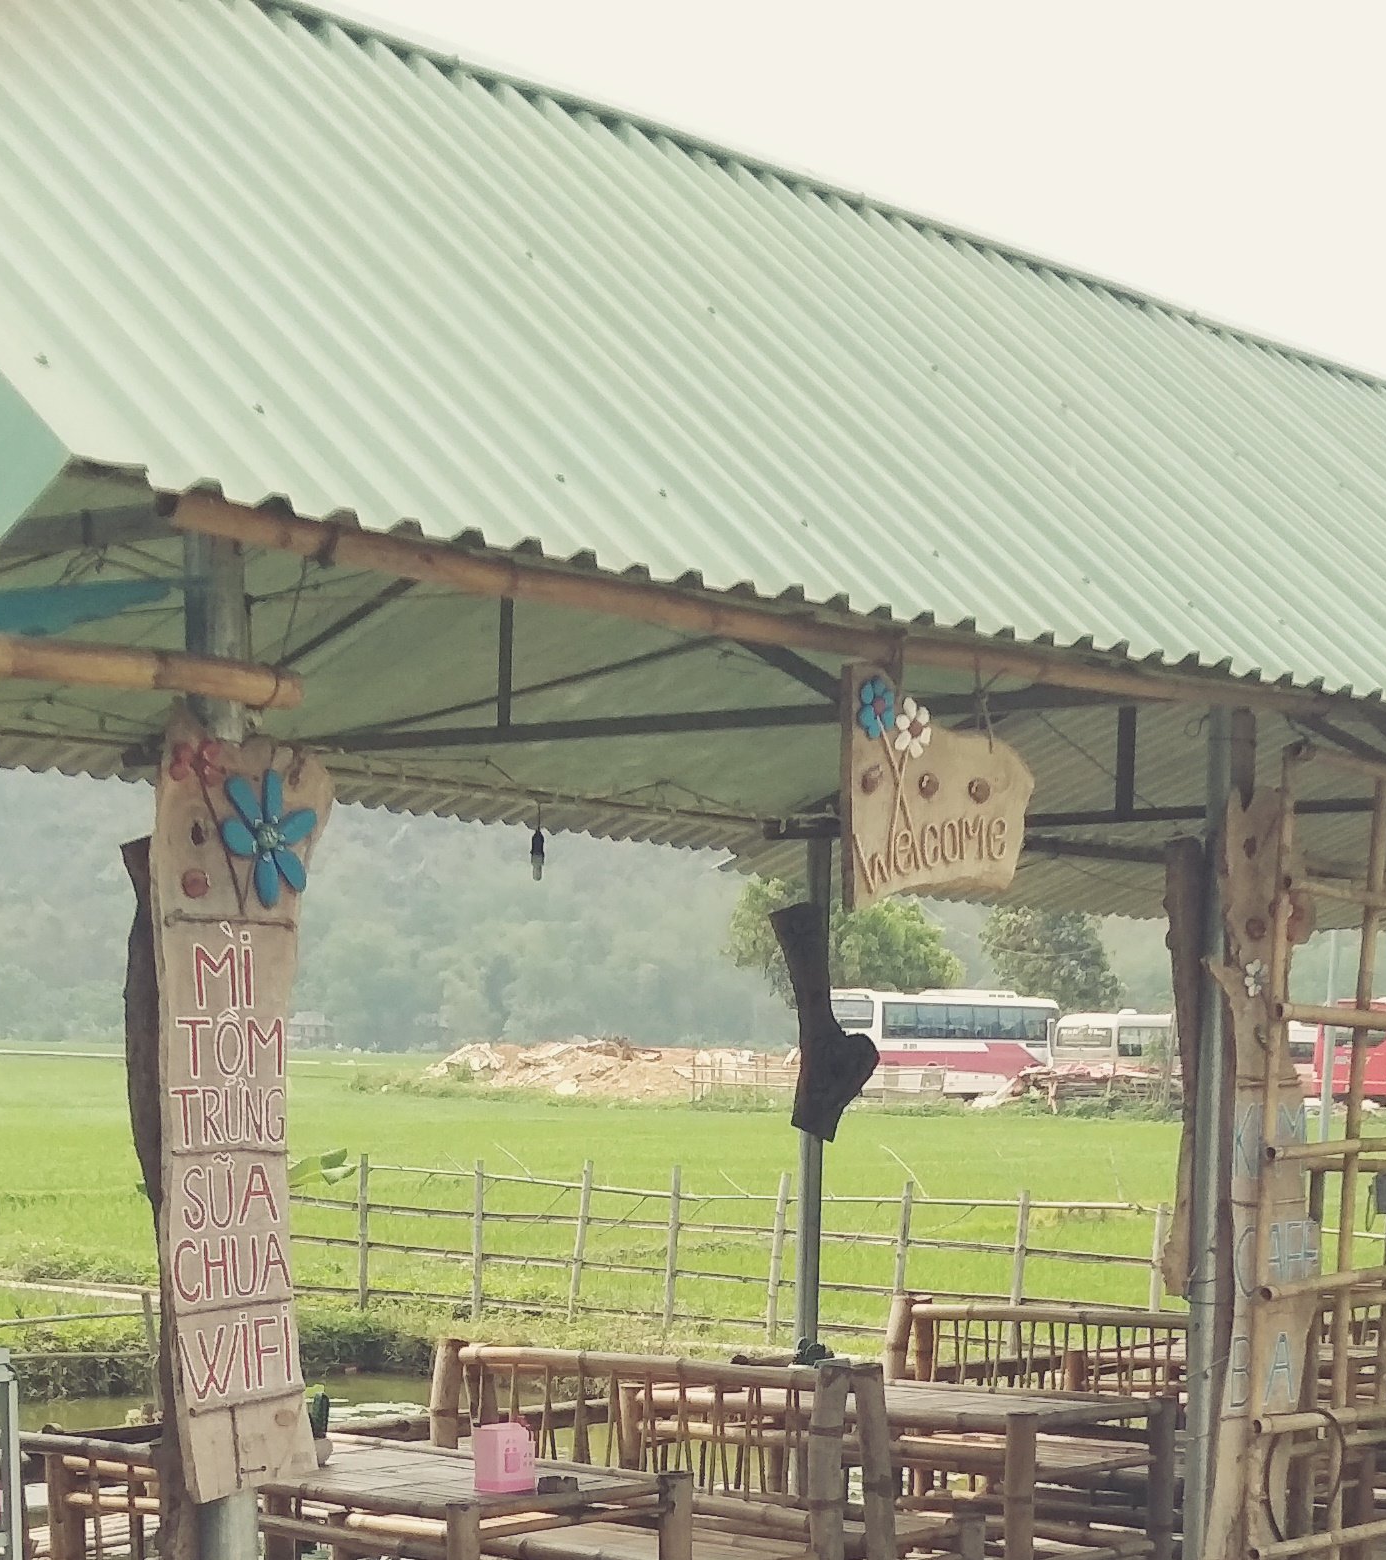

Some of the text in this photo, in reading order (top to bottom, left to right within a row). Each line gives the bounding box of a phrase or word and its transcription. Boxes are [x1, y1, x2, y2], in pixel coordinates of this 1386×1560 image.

[175, 1009, 285, 1080] TÔM
[169, 1077, 286, 1149] TRỨNG
[1233, 1102, 1306, 1179] KM
[180, 1152, 281, 1232] SỮA
[170, 1232, 293, 1304] CHUA
